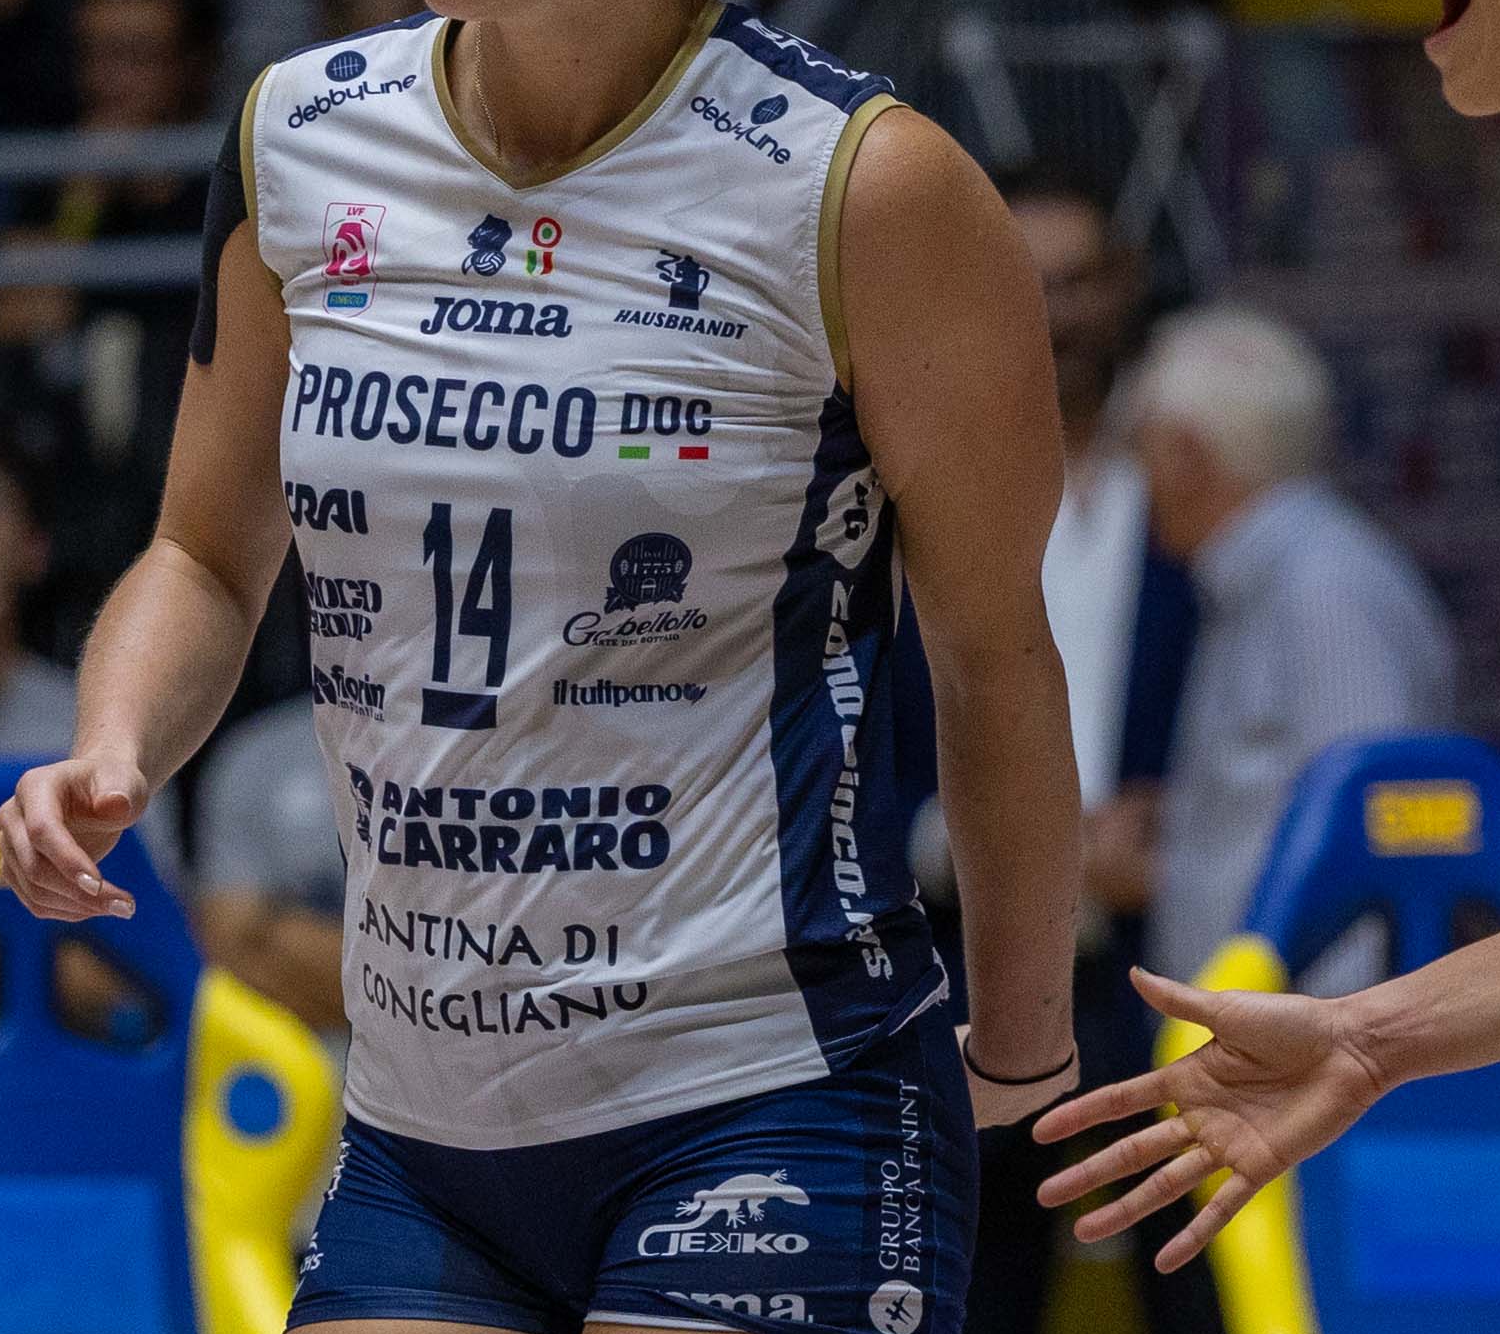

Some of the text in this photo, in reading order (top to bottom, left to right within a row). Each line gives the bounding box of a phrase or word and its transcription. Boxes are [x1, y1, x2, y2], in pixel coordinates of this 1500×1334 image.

[346, 207, 366, 217] LVF
[614, 309, 748, 340] HAUSBRANDT
[292, 364, 712, 458] PROSECCO DOC
[423, 503, 513, 688] 14
[381, 780, 672, 821] ANTONIO
[377, 817, 672, 873] CARRARO
[359, 893, 618, 966] ANTINA DI
[363, 963, 648, 1036] CONEGLIANO
[878, 1160, 902, 1270] GRUPPO
[902, 1178, 925, 1272] BANCA
